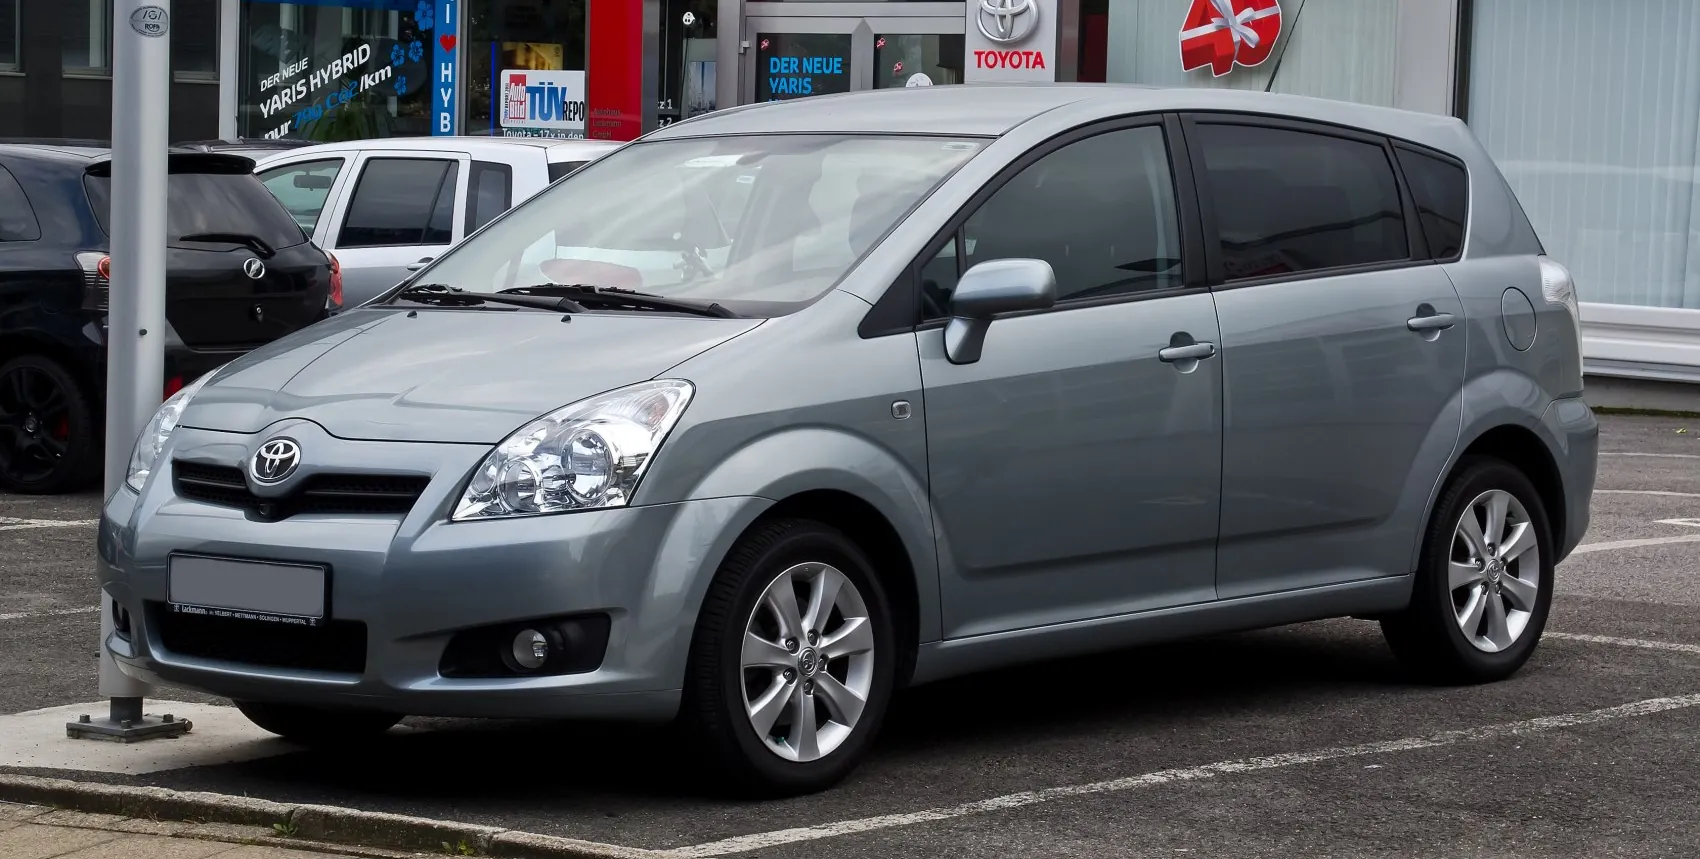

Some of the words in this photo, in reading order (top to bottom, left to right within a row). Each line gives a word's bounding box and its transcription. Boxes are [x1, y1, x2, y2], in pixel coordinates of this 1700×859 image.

[769, 57, 799, 74] DER
[802, 57, 843, 74] NEUE
[974, 50, 1045, 69] TOYOTA
[260, 71, 280, 92] DER
[281, 57, 309, 80] NEUE
[260, 79, 307, 119] YARIS
[309, 43, 371, 92] HYBRID
[509, 83, 525, 101] Auto
[769, 78, 812, 95] YARIS
[510, 101, 525, 119] Bild
[525, 82, 567, 121] TÜV
[667, 99, 673, 109] 1
[264, 120, 291, 139] nur
